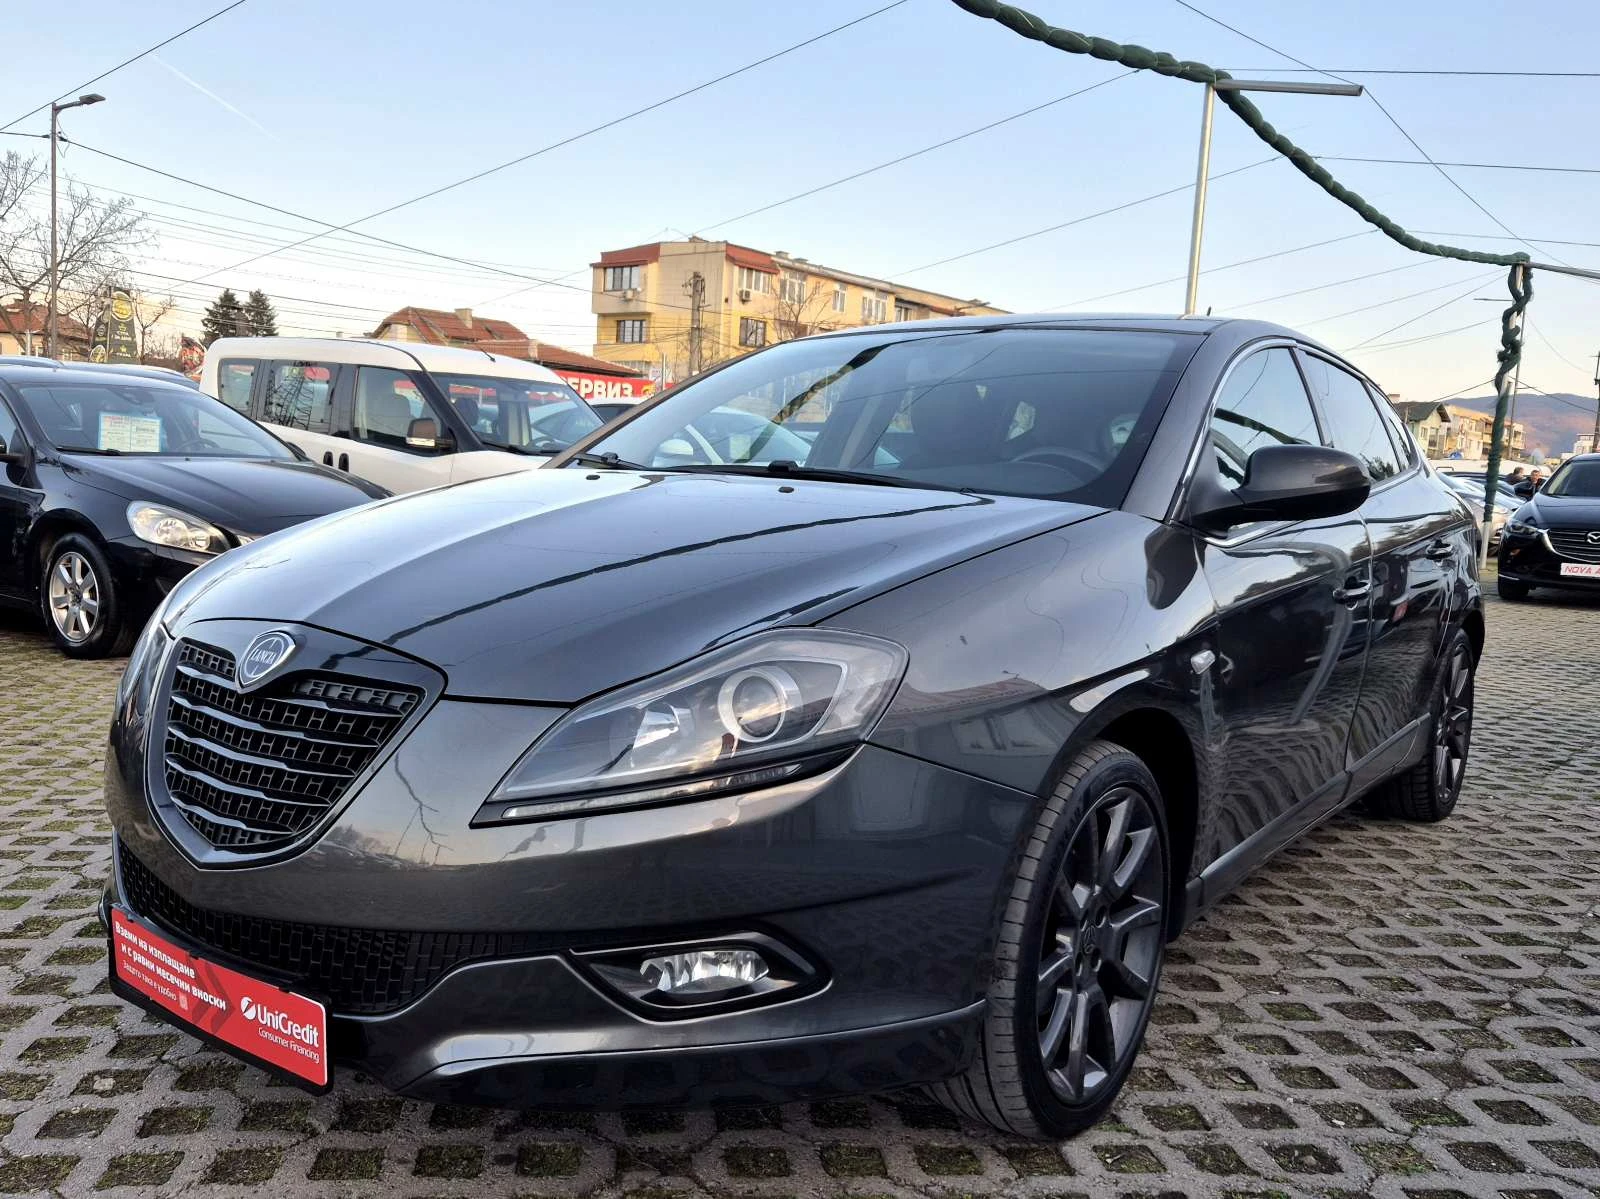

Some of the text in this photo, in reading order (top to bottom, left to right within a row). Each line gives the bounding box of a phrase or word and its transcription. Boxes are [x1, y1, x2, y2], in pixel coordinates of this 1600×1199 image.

[561, 376, 633, 399] ЕРВИЗ
[1565, 566, 1592, 574] NOVA
[115, 921, 195, 979] Вземи на изплащане
[133, 952, 155, 972] равни
[156, 965, 191, 993] месечни
[191, 985, 226, 1011] вноски
[257, 1003, 320, 1048] UniCredit
[258, 1027, 320, 1064] Consumer Financing
